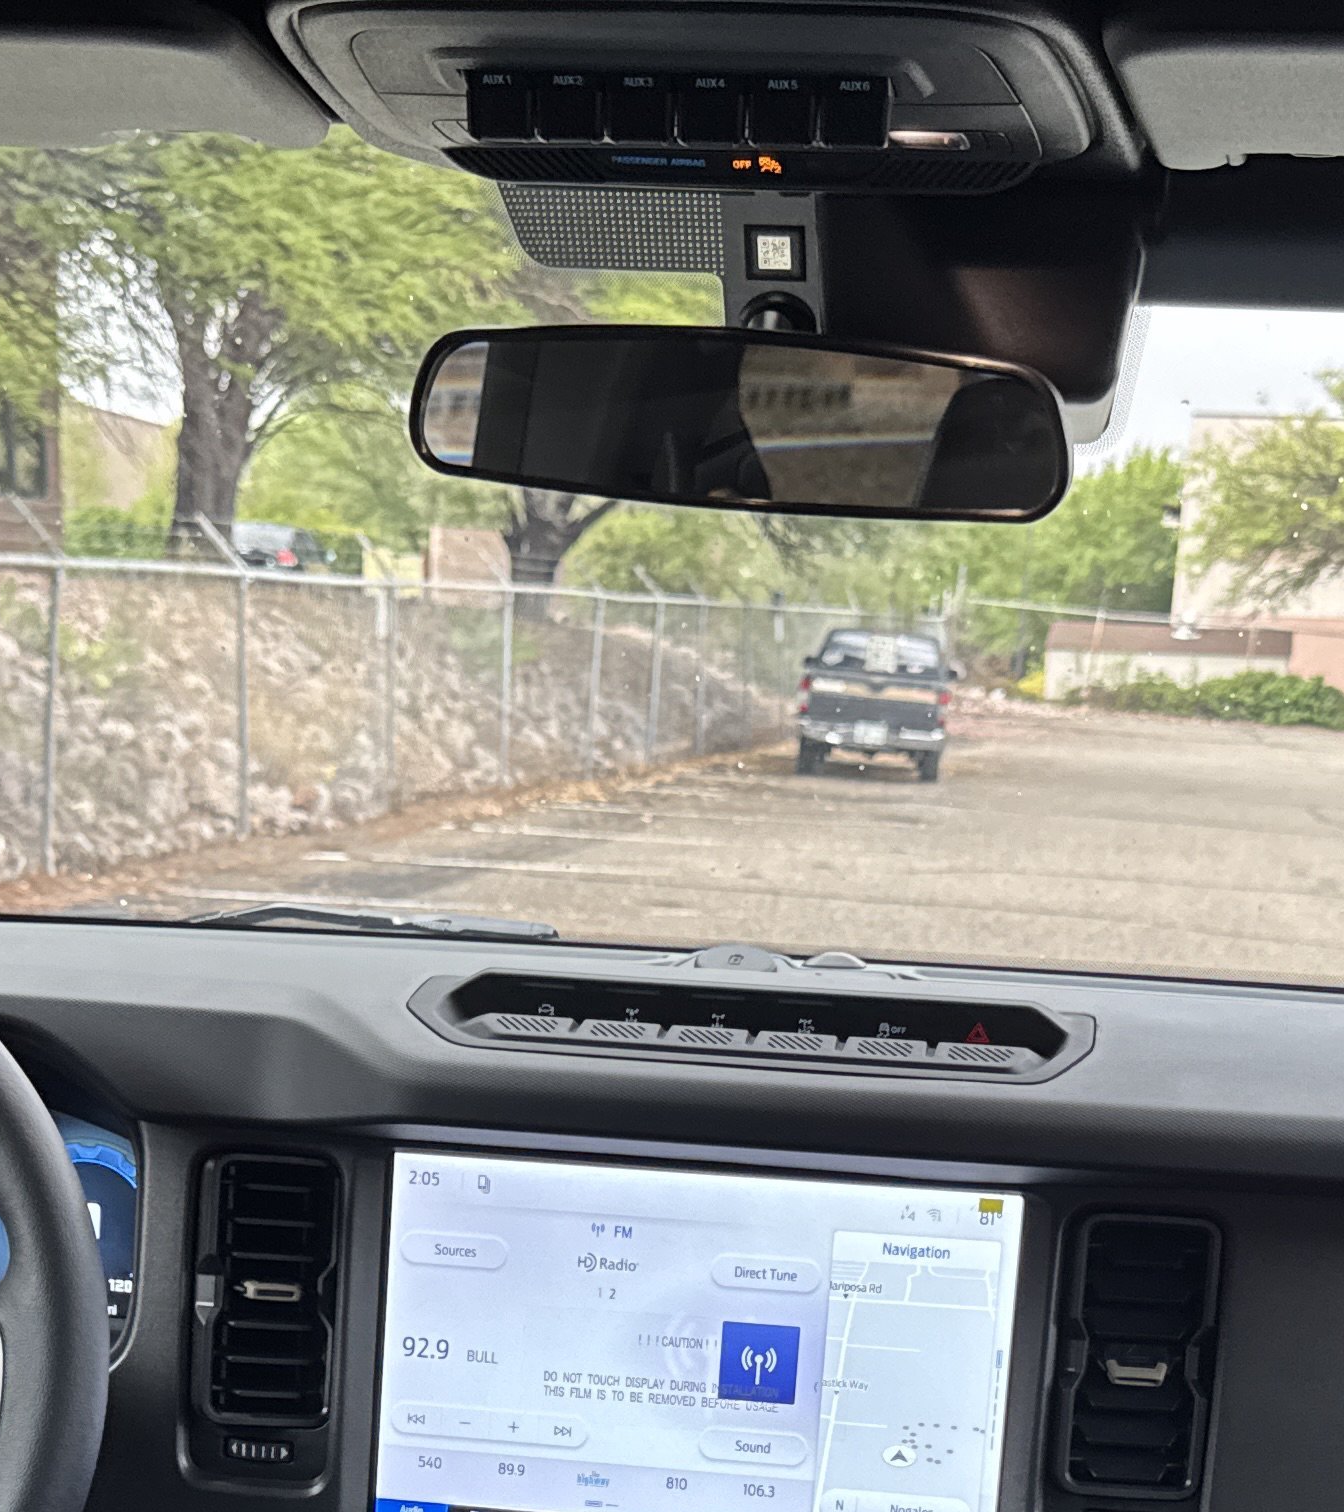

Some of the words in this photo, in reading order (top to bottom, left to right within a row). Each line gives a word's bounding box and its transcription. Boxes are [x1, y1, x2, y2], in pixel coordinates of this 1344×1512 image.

[670, 158, 706, 168] AIRBAG
[732, 160, 752, 170] OFF
[408, 1170, 441, 1187] 2:05
[614, 1225, 634, 1239] FM
[434, 1243, 477, 1258] Sources
[882, 1242, 951, 1261] Navigation
[599, 1257, 637, 1273] Radio
[734, 1265, 767, 1281] Direct
[770, 1268, 798, 1283] Tune
[609, 1288, 616, 1300] 2
[869, 1283, 883, 1294] Rd
[402, 1335, 450, 1360] 92.9
[466, 1350, 499, 1365] BULL
[543, 1370, 557, 1382] DO
[562, 1371, 583, 1384] NOT
[588, 1373, 621, 1387] TOUCH
[625, 1376, 665, 1391] DISPLAY
[669, 1379, 706, 1394] DURING
[820, 1379, 848, 1389] astick
[849, 1380, 869, 1392] Way
[543, 1385, 565, 1398] THIS
[569, 1386, 592, 1399] FILM
[597, 1388, 607, 1400] IS
[611, 1389, 625, 1401] TO
[629, 1391, 644, 1404] BE
[648, 1392, 697, 1408] REMOVED
[701, 1396, 741, 1411] BEFORE
[734, 1438, 772, 1455] Sound
[417, 1455, 443, 1470] 540
[497, 1461, 526, 1477] 89.9
[665, 1476, 688, 1491] 810
[742, 1483, 776, 1499] 106.3
[834, 1499, 844, 1512] N
